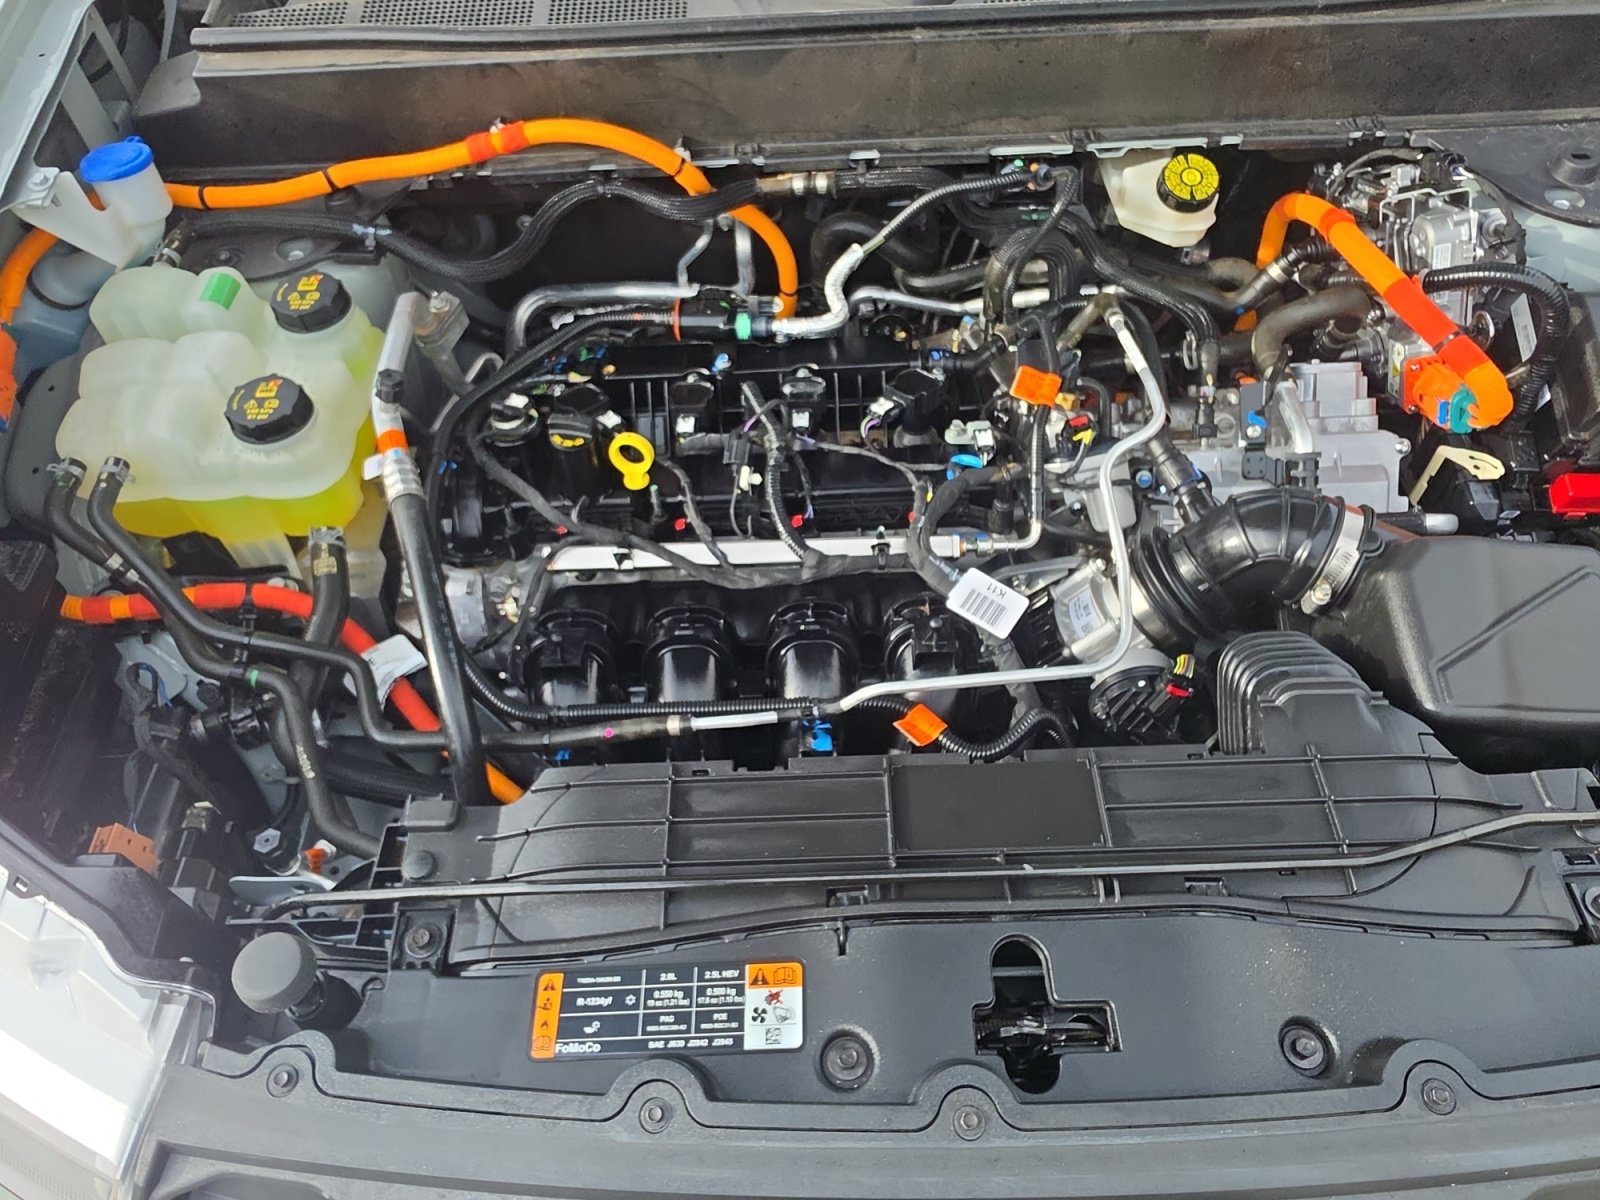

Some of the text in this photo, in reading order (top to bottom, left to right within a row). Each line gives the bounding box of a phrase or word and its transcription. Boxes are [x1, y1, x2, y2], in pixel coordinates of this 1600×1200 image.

[987, 583, 1007, 599] K11
[721, 969, 740, 978] HEV
[674, 989, 684, 999] kg
[727, 987, 737, 996] kg
[576, 996, 613, 1007] R-1234yf
[555, 1042, 601, 1054] FoMoCo
[648, 1040, 665, 1049] SAE
